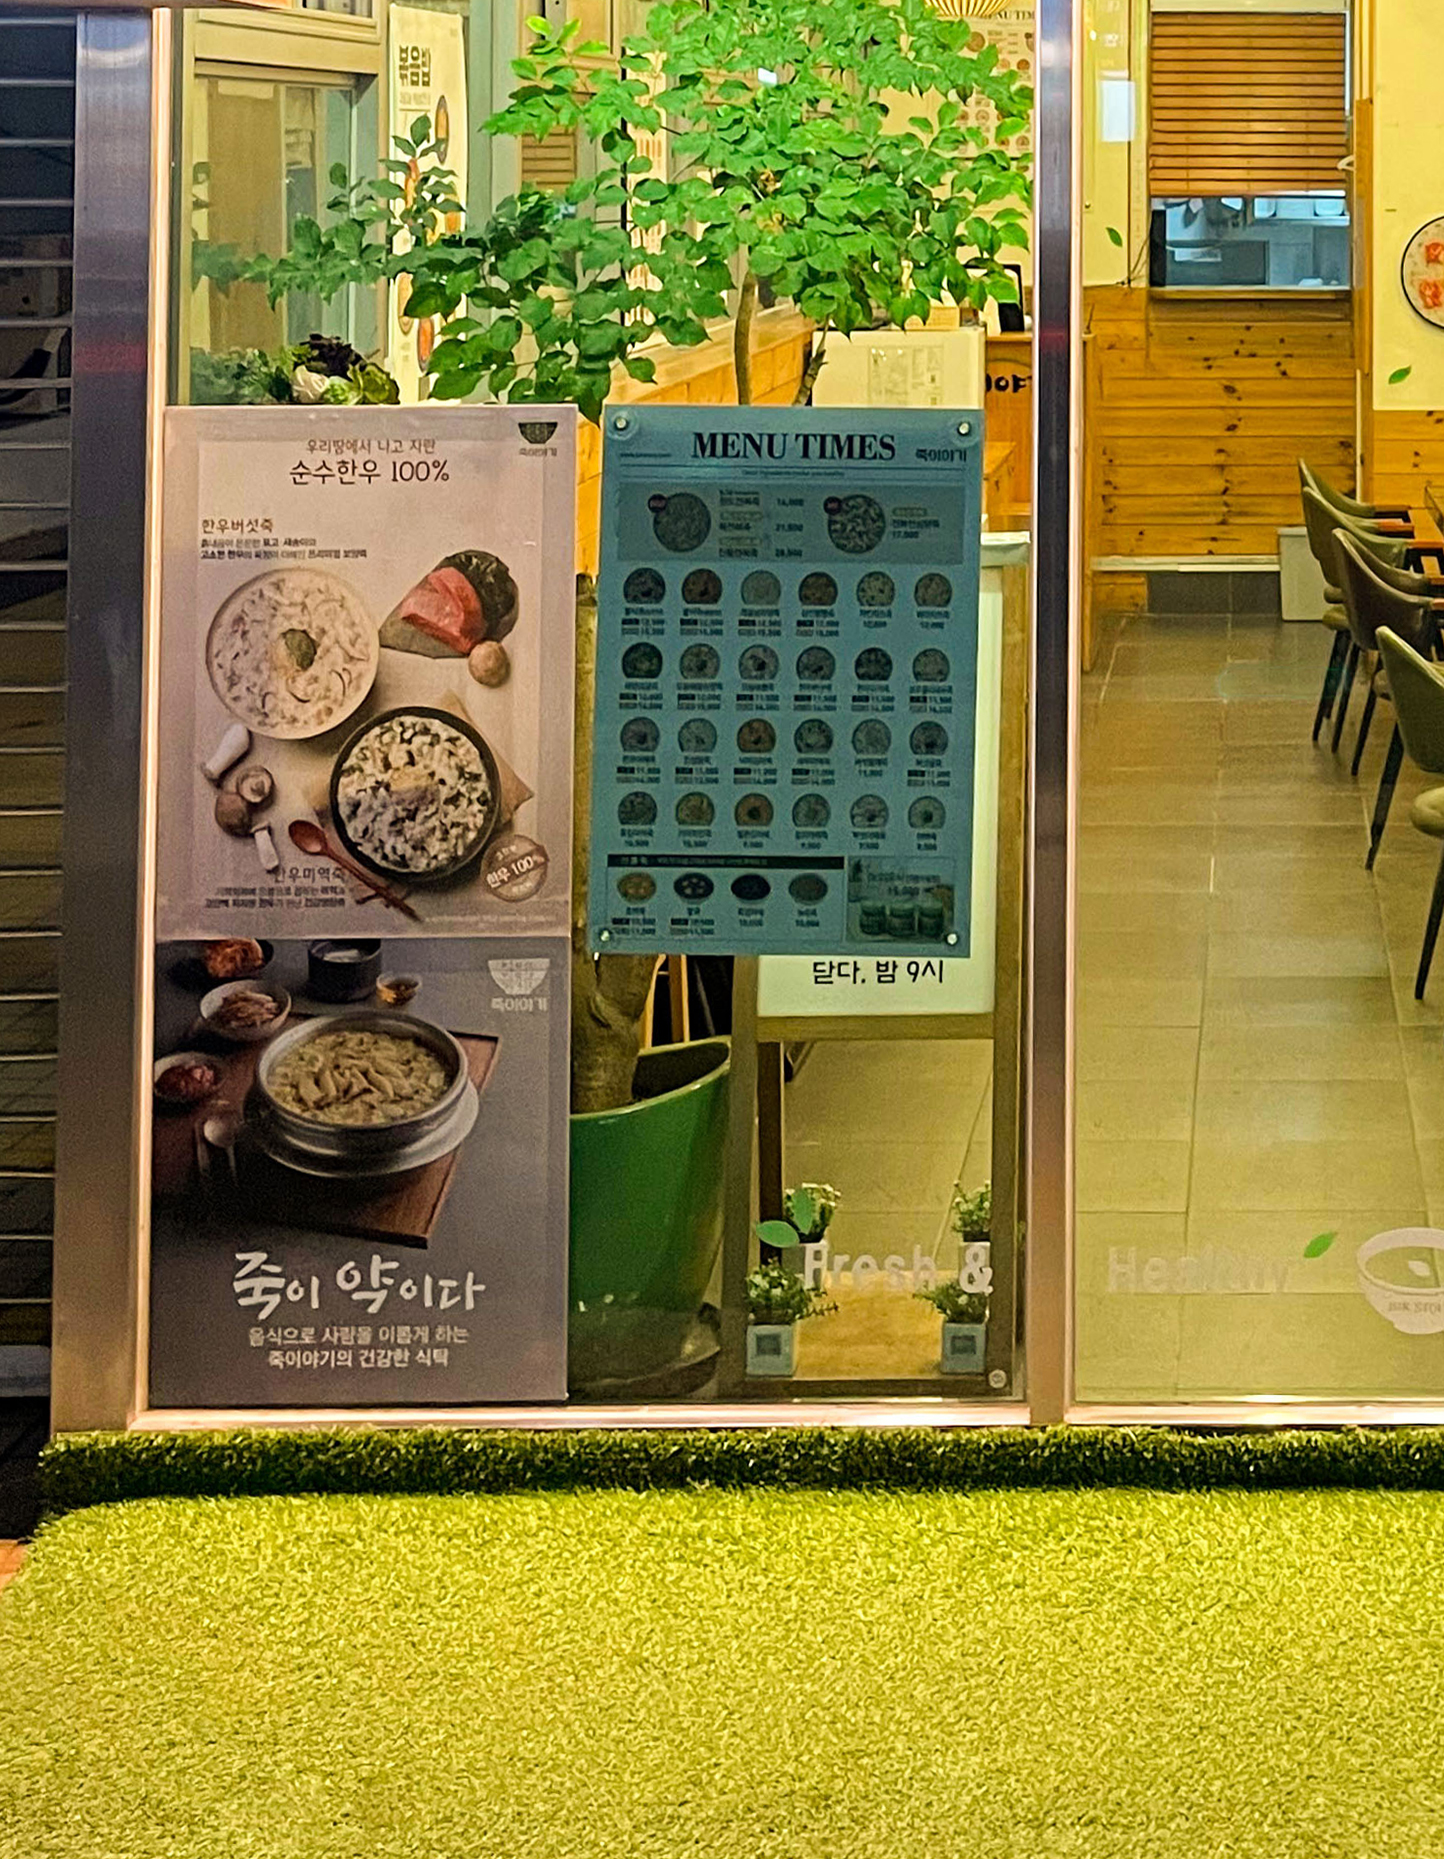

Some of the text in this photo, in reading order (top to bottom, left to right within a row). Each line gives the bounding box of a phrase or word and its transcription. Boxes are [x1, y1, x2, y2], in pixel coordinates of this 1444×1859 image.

[692, 431, 896, 461] MENU TIMES
[290, 459, 450, 486] 순수한우 100%
[202, 519, 273, 535] 한우버섯죽
[876, 960, 898, 984] 밤
[906, 960, 944, 984] 9시
[804, 1241, 937, 1291] Fresh
[958, 1244, 994, 1295] &
[233, 1251, 487, 1321] 죽이 약이다
[249, 1326, 316, 1347] 음식으로
[322, 1325, 373, 1346] 사람을
[435, 1325, 469, 1345] 하는
[268, 1349, 353, 1369] 죽이야기의
[358, 1348, 410, 1369] 건강한
